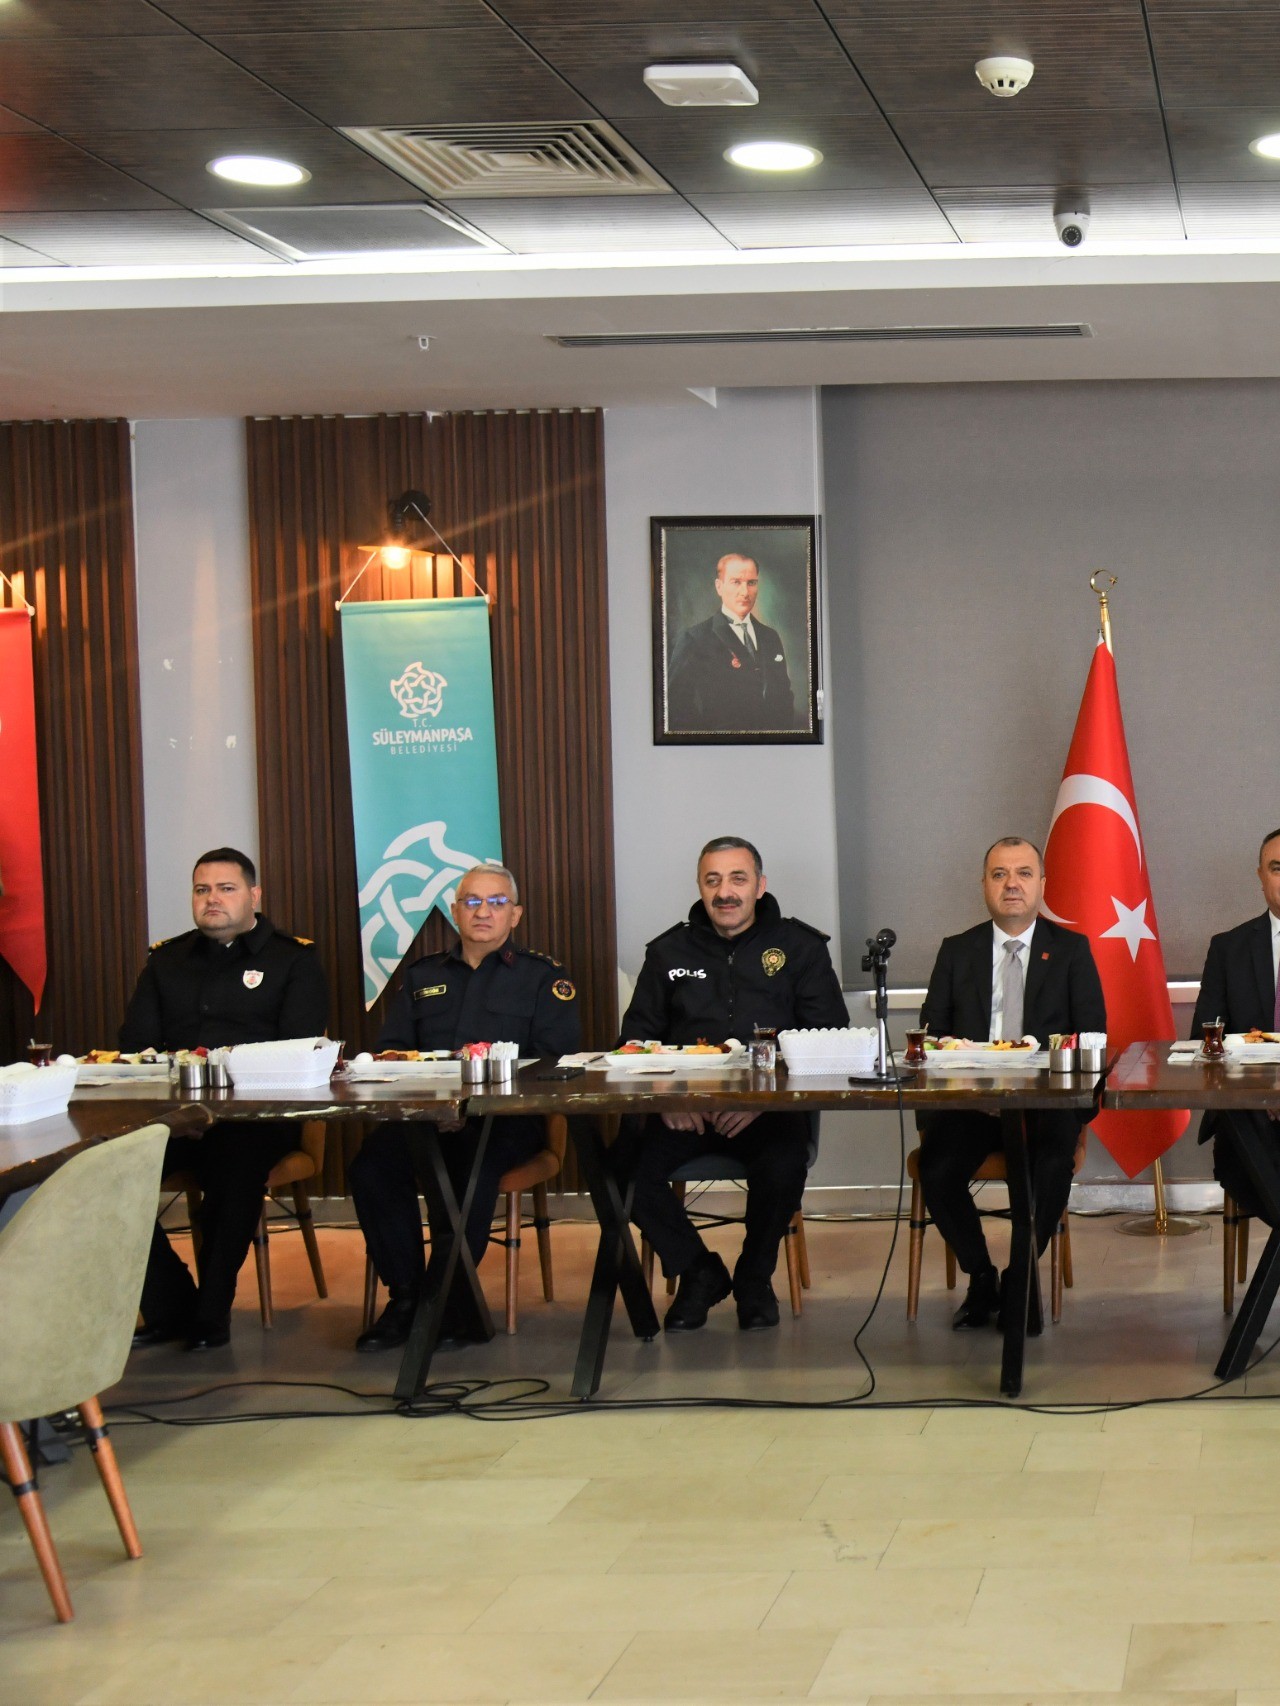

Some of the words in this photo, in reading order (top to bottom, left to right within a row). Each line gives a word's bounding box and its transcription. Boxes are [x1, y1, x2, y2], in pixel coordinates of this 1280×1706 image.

[413, 718, 432, 727] T.C.
[372, 728, 473, 745] SÜLEYMANPAŞA
[390, 743, 457, 755] BELEDİYESİ
